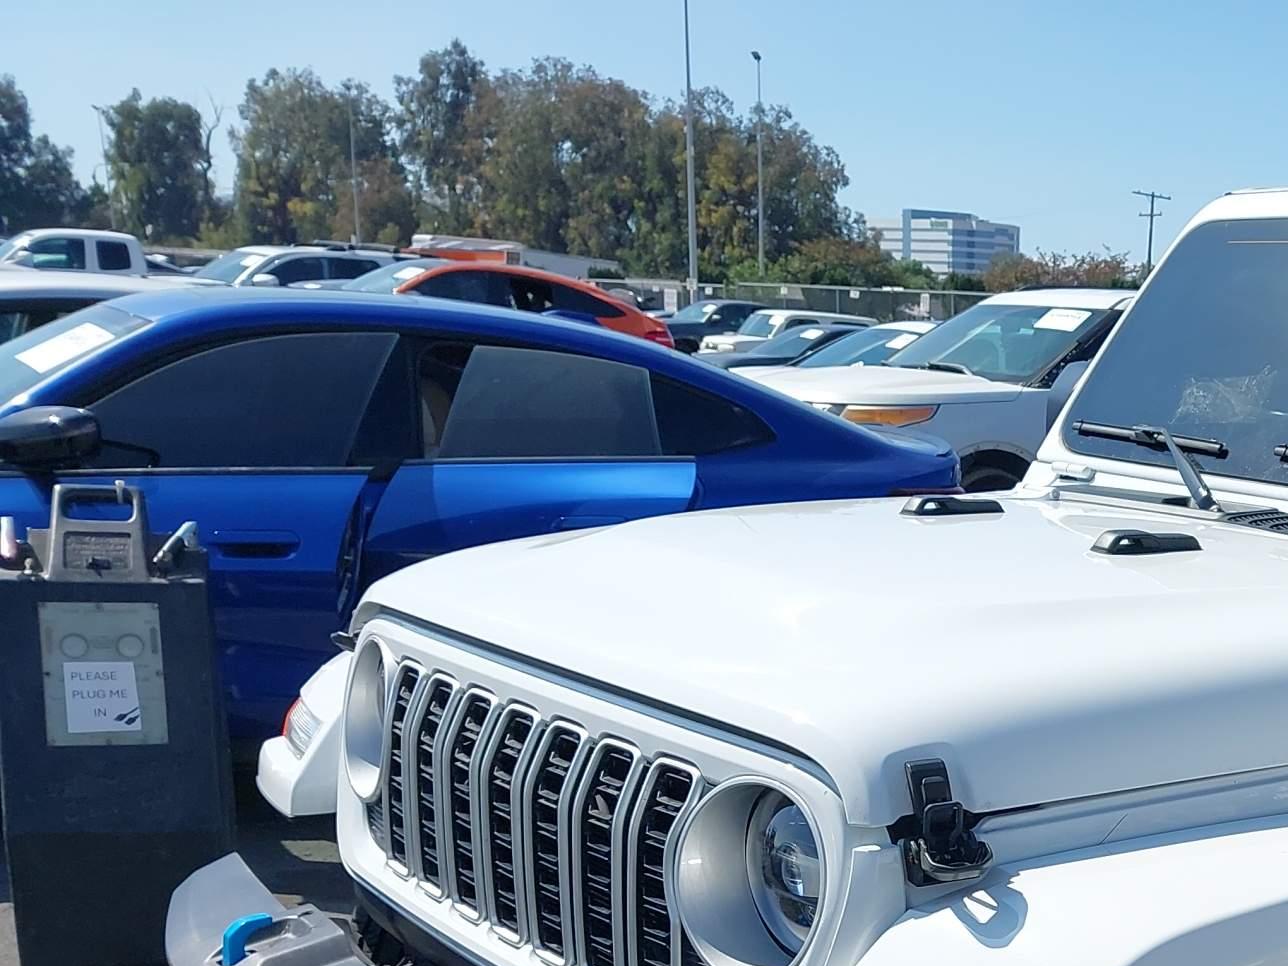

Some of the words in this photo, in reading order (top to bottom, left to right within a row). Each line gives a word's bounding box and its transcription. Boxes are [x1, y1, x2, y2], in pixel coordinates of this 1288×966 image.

[70, 671, 118, 681] PLEASE
[71, 690, 107, 699] PLUG
[109, 689, 128, 699] ME
[93, 708, 107, 718] IN
